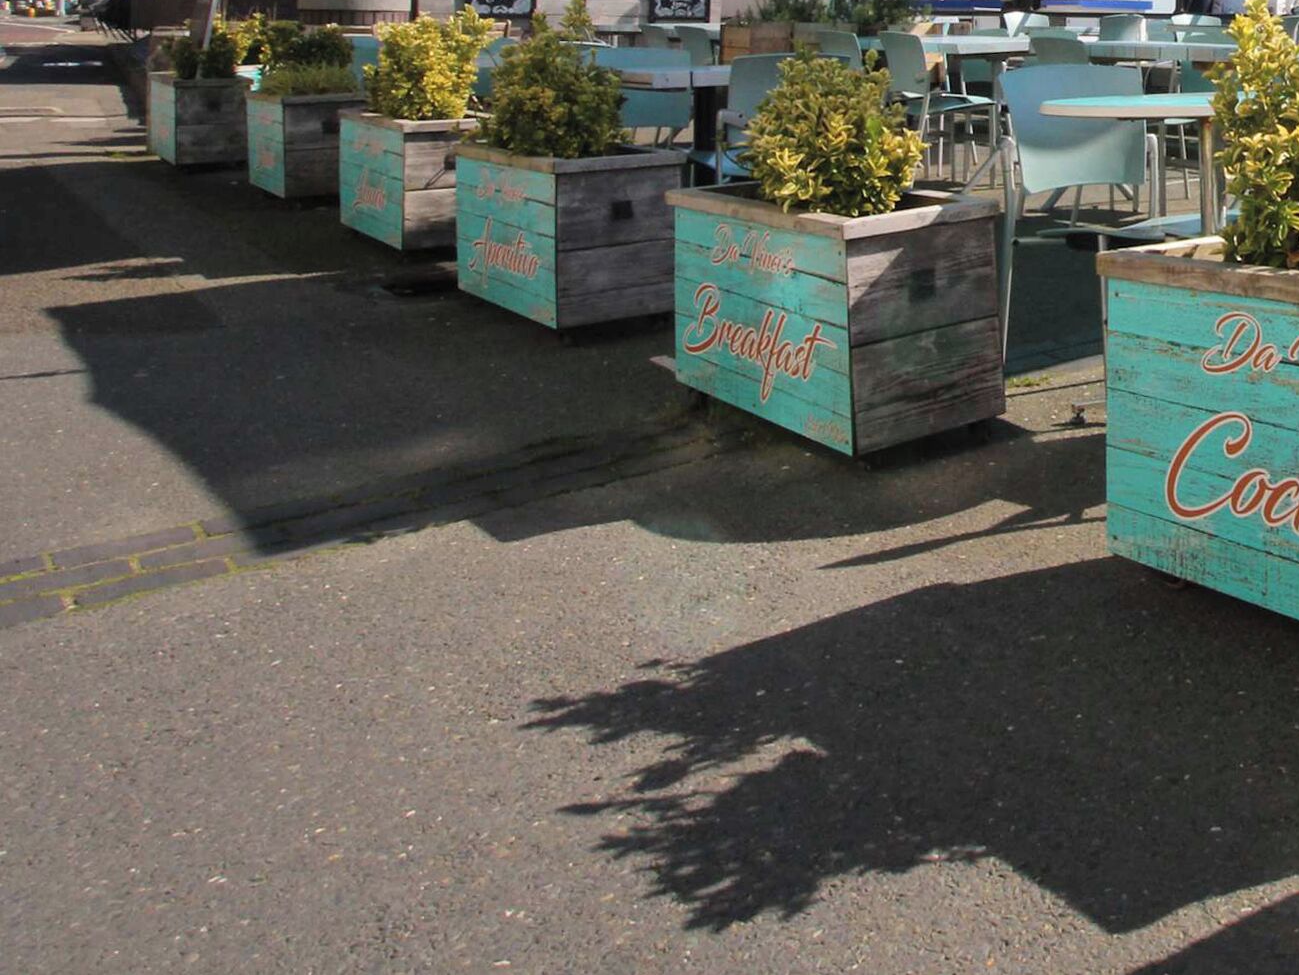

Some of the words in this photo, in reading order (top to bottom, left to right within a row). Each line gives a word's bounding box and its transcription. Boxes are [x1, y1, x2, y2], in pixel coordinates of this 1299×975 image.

[711, 223, 739, 266] Da
[683, 283, 837, 404] Breakfast
[1202, 312, 1281, 373] Da
